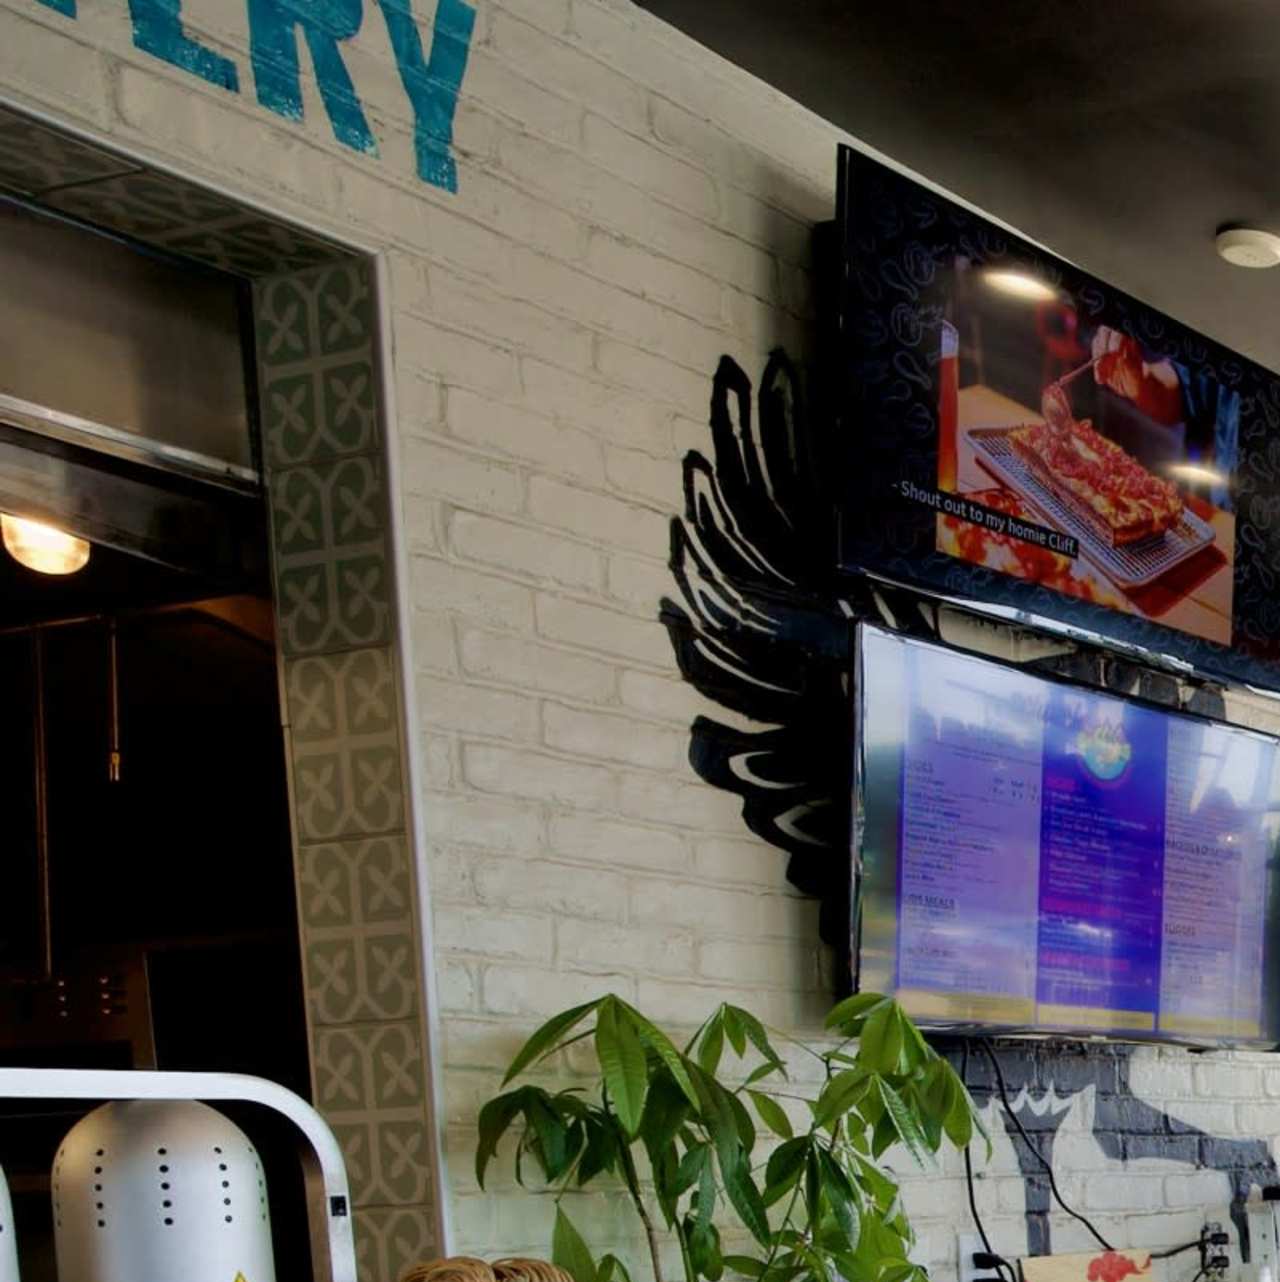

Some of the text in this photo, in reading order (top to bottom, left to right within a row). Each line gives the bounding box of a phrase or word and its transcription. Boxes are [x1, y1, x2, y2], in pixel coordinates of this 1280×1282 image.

[900, 479, 942, 509] Shout
[944, 500, 967, 518] out
[970, 506, 984, 523] to
[986, 513, 1005, 532] my
[1049, 533, 1077, 556] Cliff.
